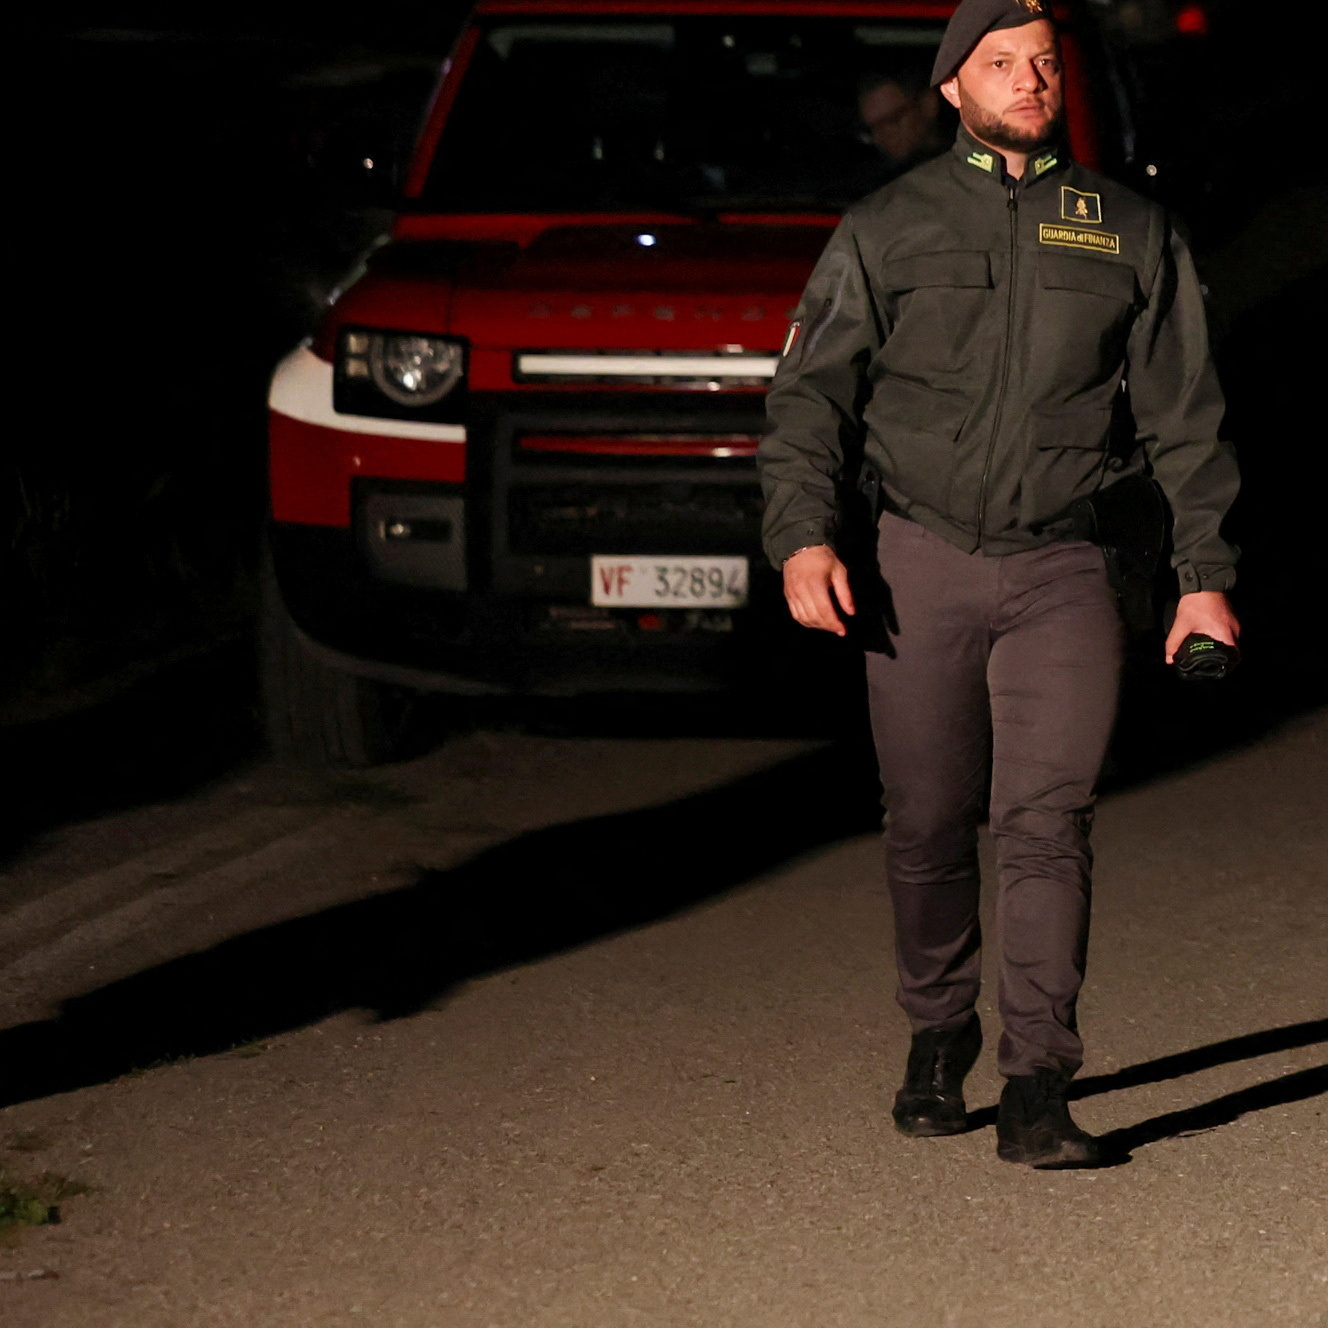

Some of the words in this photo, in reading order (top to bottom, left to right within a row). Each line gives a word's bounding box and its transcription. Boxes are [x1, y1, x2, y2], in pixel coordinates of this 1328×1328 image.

[1042, 227, 1077, 242] GUARDIA
[1077, 233, 1084, 243] di
[1084, 232, 1116, 249] FINANZA
[599, 564, 634, 597] VF
[654, 565, 743, 599] 32894
